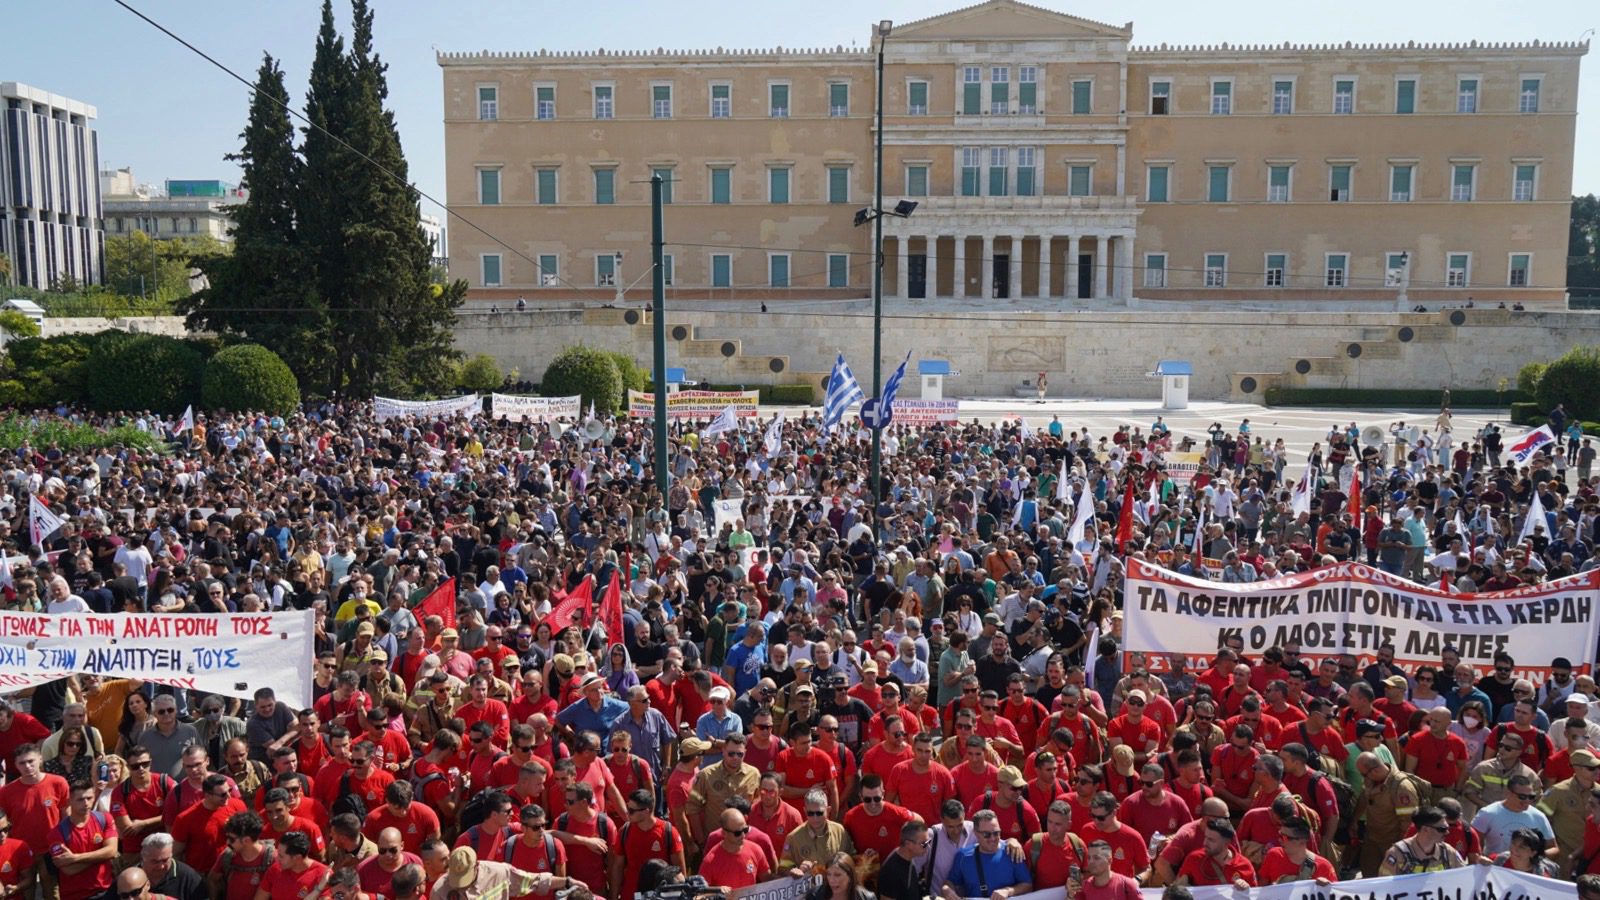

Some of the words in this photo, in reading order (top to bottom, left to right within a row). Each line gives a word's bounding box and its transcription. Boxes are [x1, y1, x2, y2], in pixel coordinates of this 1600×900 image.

[1138, 586, 1168, 613] ΤΑ
[1175, 591, 1299, 619] ΑΦΕΝΤΙΚΑ
[1307, 588, 1443, 624] ΠΝΙΓΟΝΤΑΙ
[1447, 603, 1503, 625] ΣΤΑ
[1506, 597, 1591, 624] ΚΕΡΔΗ
[59, 618, 82, 637] ΓΙΑ
[86, 617, 114, 637] ΤΗΝ
[123, 617, 218, 638] ΑΝΑΤΡΟΠΗ
[231, 616, 273, 635] ΤΟΥΣ
[1250, 625, 1266, 649] Ο
[1272, 622, 1336, 648] ΛΑΟΣ
[1342, 622, 1397, 651] ΣΤΙΣ
[38, 649, 77, 670] ΣΤΗΝ
[83, 648, 181, 673] ΑΝΑΠΤΥΞΗ
[193, 647, 241, 669] ΤΟΥΣ
